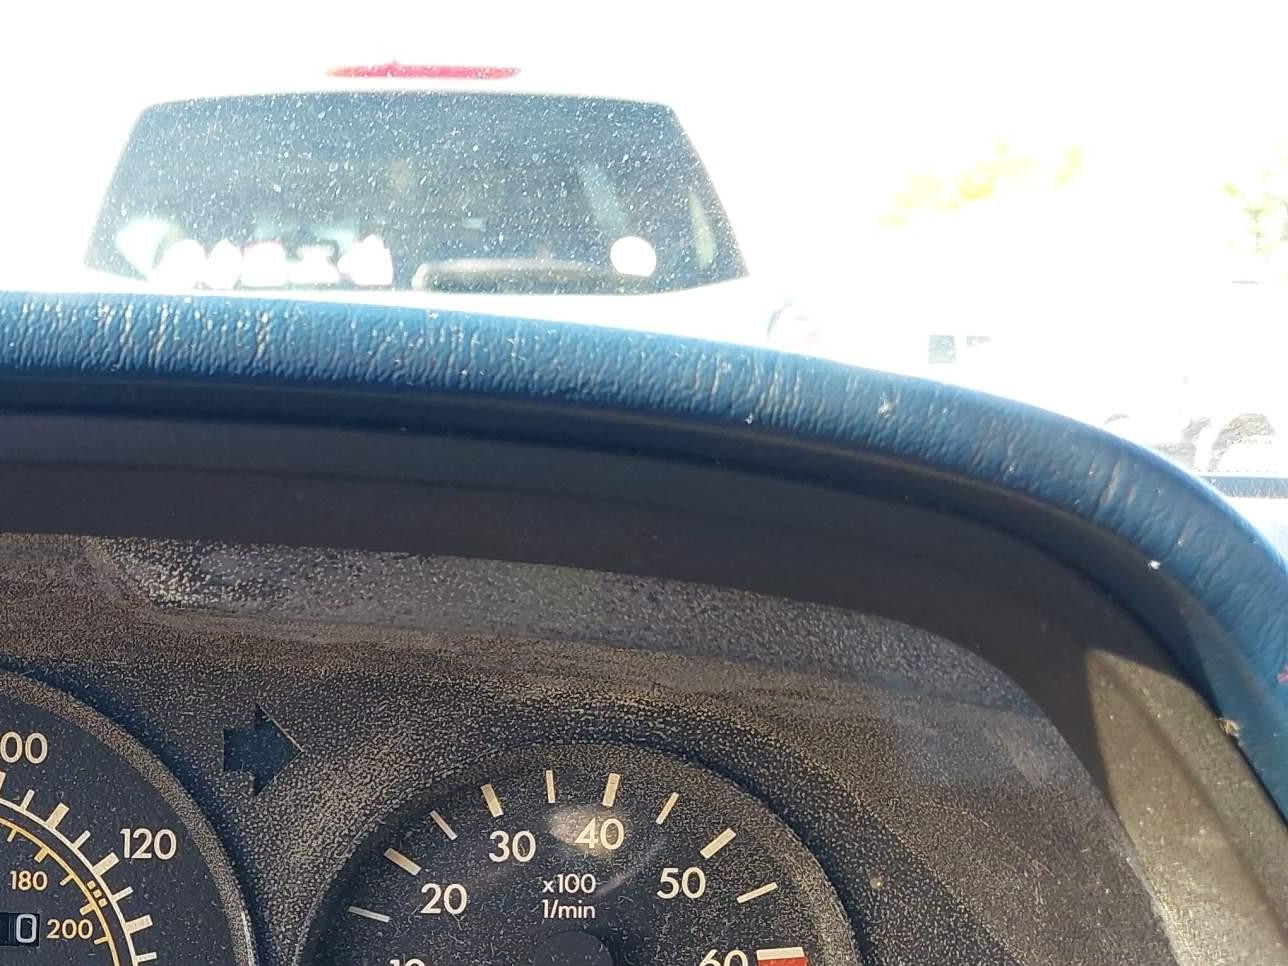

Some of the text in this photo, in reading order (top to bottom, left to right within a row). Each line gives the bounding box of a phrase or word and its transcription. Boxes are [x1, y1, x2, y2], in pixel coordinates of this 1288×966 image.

[120, 829, 177, 859] 120
[488, 830, 536, 863] 30
[574, 818, 624, 850] 40
[10, 870, 48, 892] 180
[542, 873, 596, 894] x100
[657, 867, 705, 899] 50
[420, 883, 468, 914] 20
[542, 899, 595, 920] 1/min
[46, 919, 93, 940] 200
